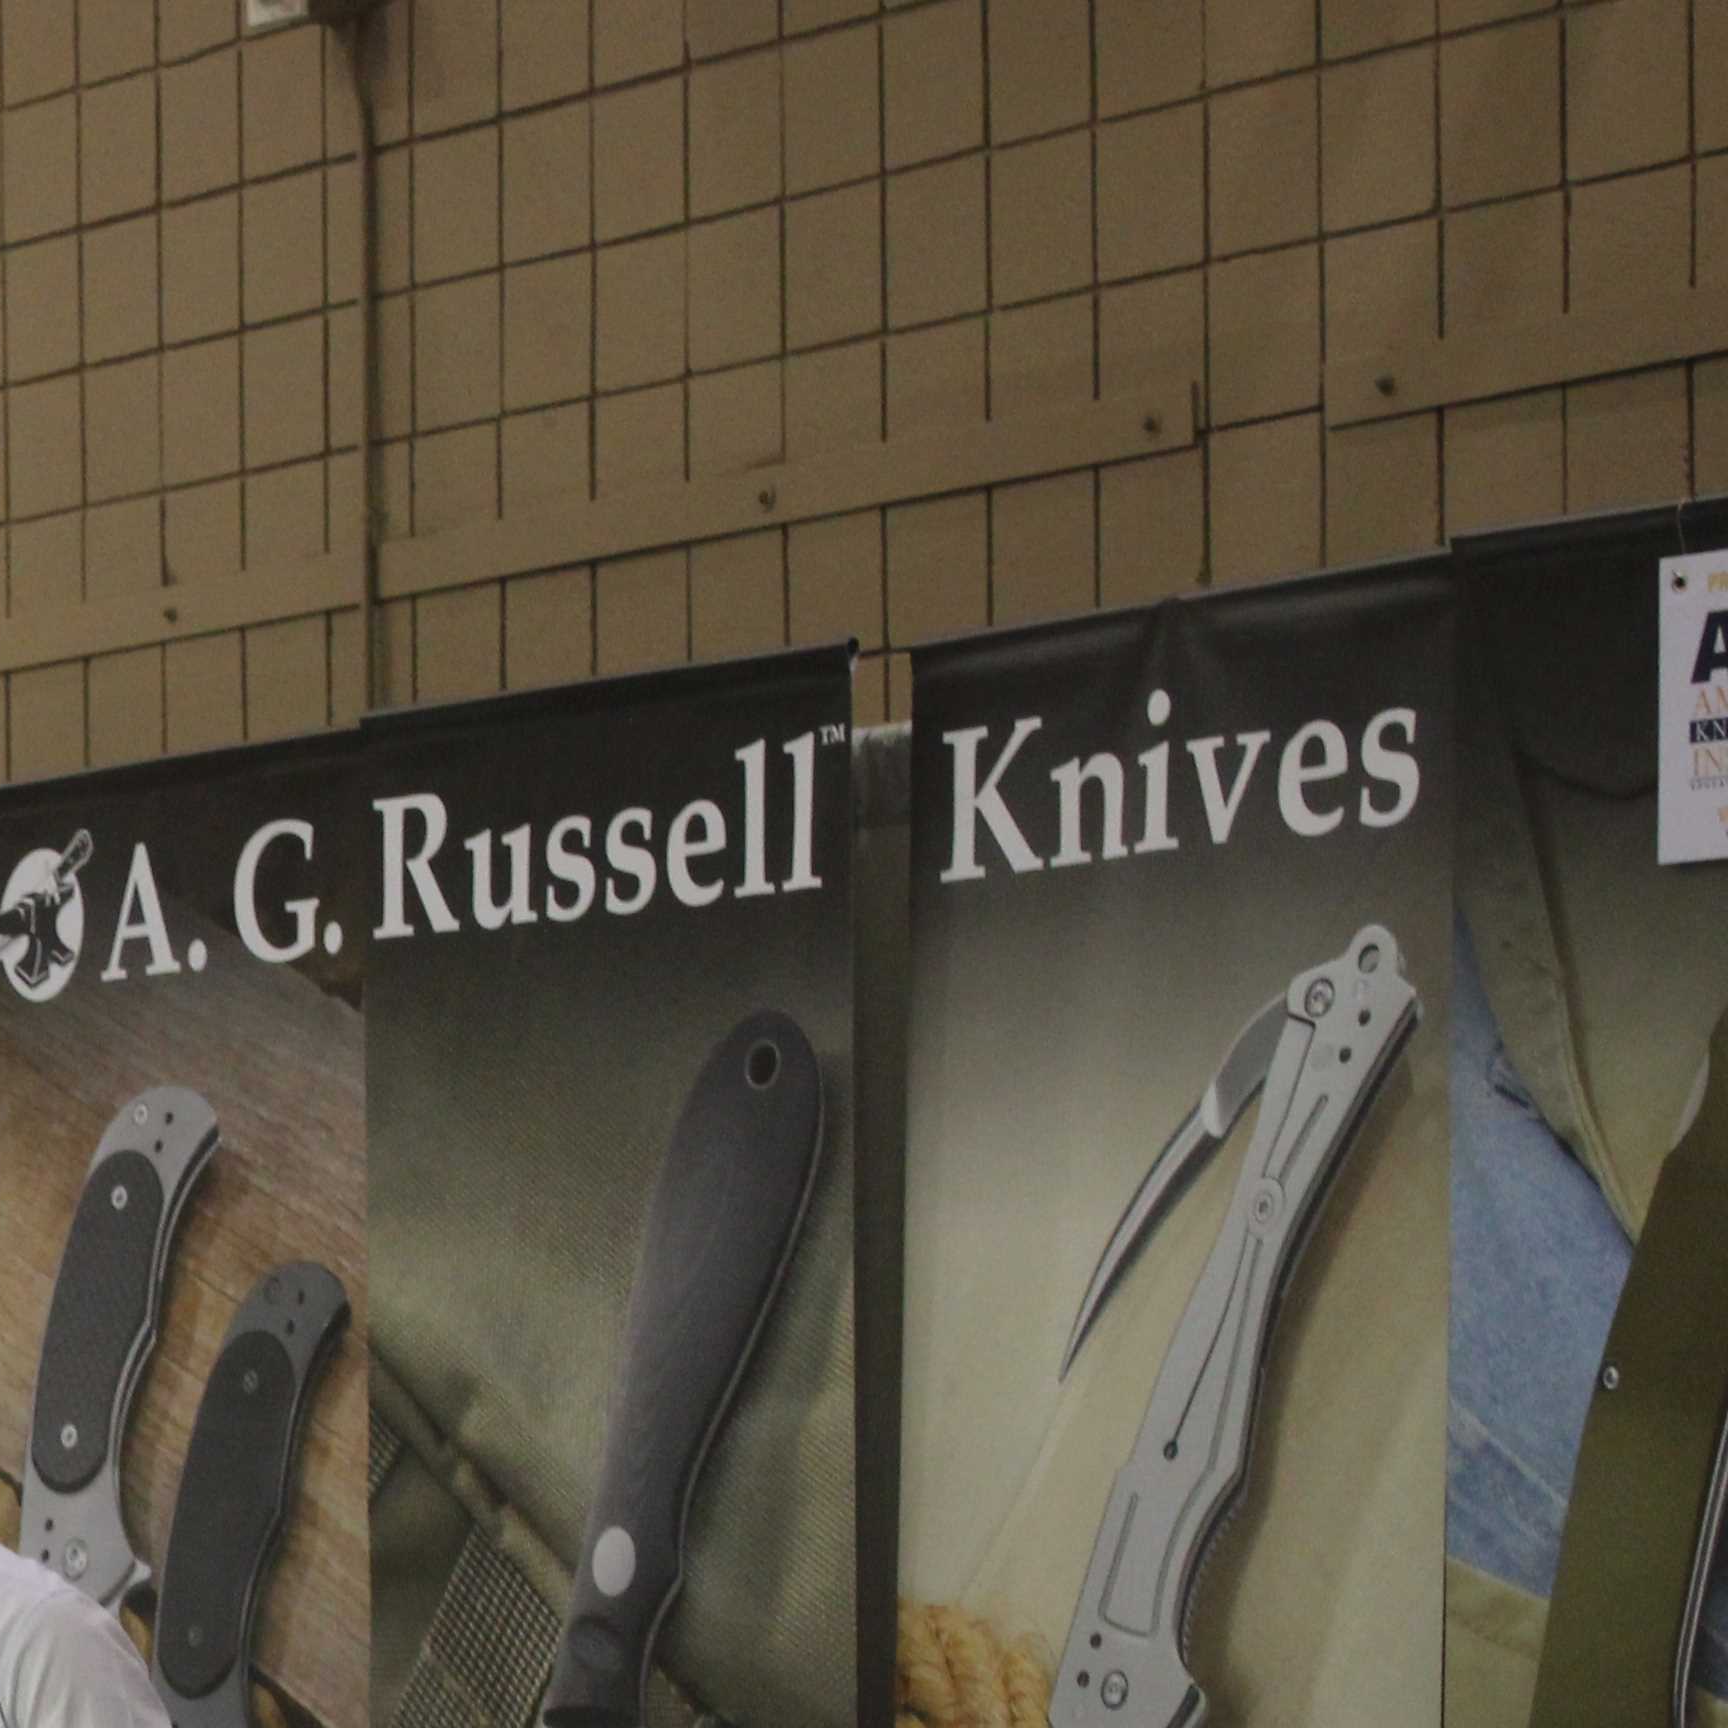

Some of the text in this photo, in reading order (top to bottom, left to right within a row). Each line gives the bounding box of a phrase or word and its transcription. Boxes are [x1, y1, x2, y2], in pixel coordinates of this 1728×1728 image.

[100, 841, 208, 983] A.
[233, 818, 343, 965] G.
[372, 731, 824, 940] Russell
[940, 687, 1421, 884] Knives
